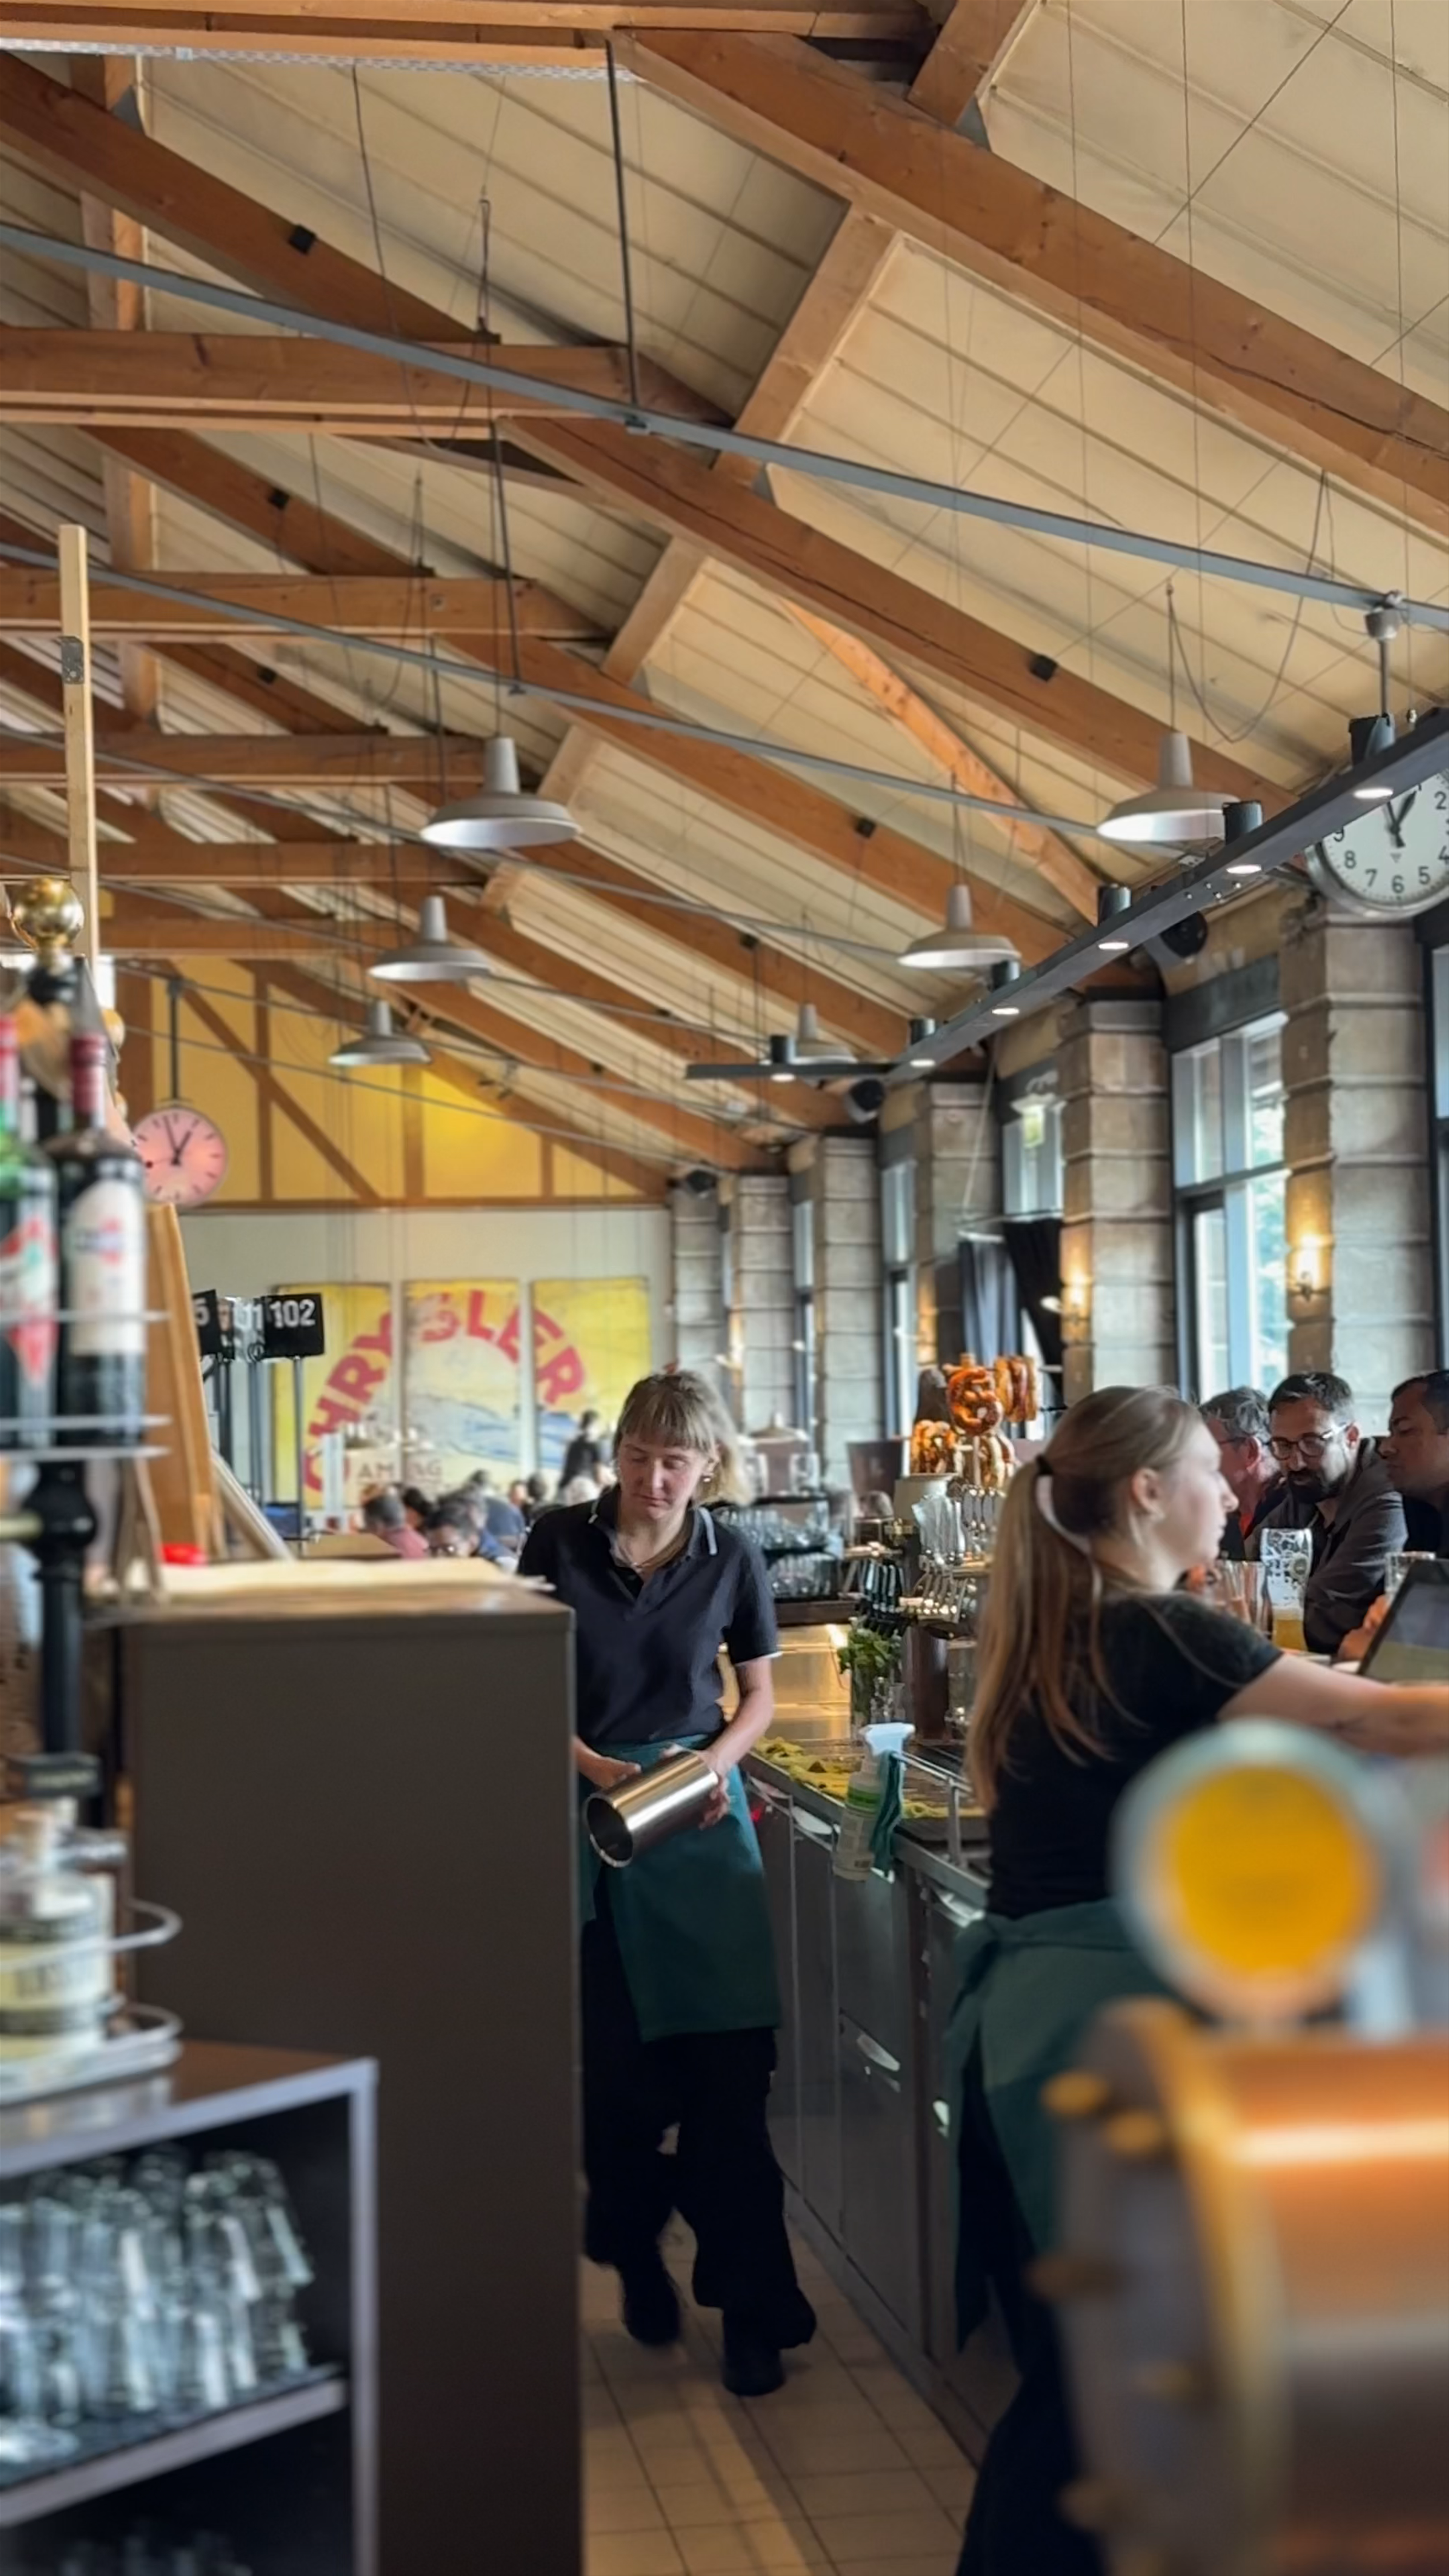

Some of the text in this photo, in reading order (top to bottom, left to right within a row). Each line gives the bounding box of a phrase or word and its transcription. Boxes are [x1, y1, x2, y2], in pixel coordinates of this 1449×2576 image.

[1434, 791, 1447, 810] 2
[1344, 850, 1356, 869] 8
[1365, 869, 1377, 887] 7
[1392, 875, 1404, 894] 6
[1418, 866, 1430, 885] 5
[269, 1299, 315, 1328] 102
